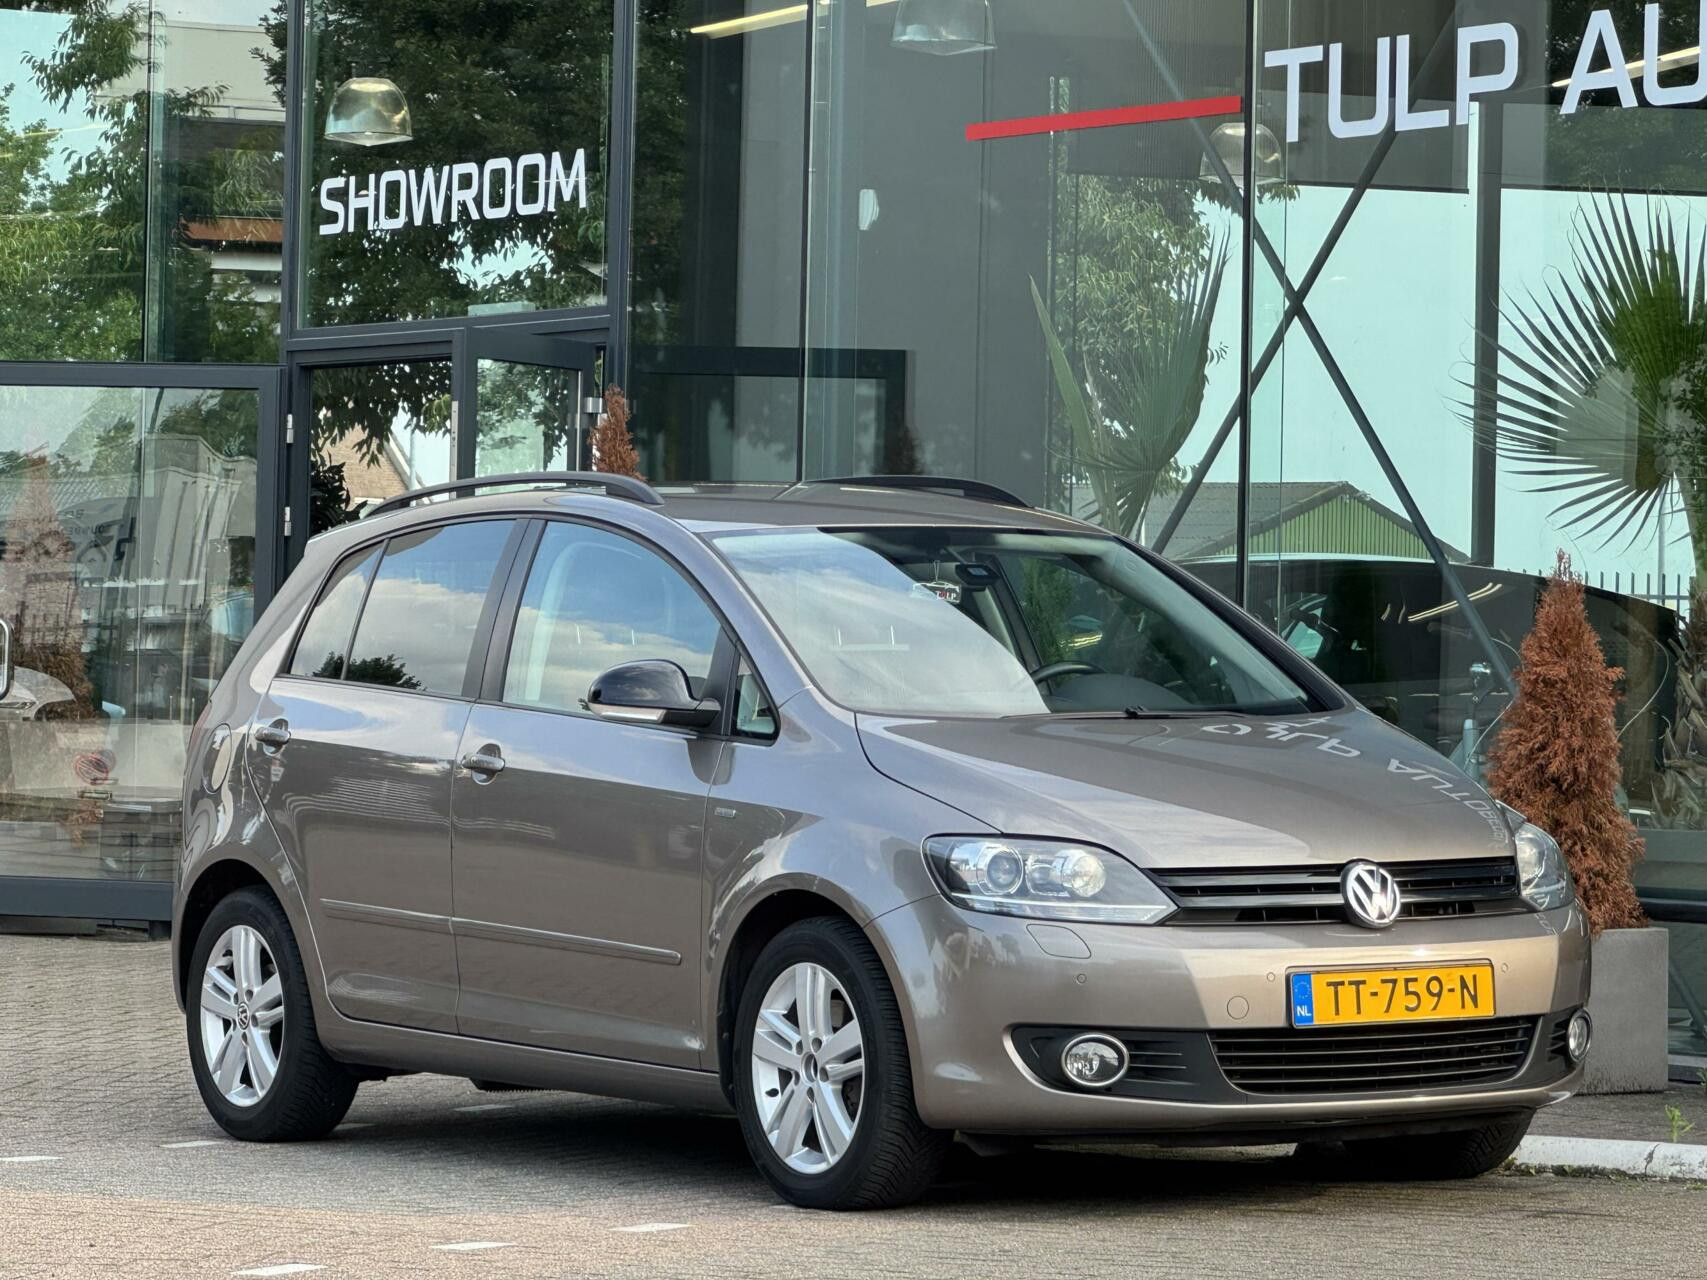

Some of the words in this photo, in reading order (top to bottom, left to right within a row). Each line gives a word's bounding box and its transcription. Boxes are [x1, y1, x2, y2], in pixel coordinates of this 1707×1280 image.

[1264, 23, 1519, 143] TULP
[1559, 0, 1707, 115] AU
[318, 148, 588, 236] SHOWROOM
[1296, 1005, 1312, 1017] NL
[1326, 974, 1479, 1017] TT-759-N
